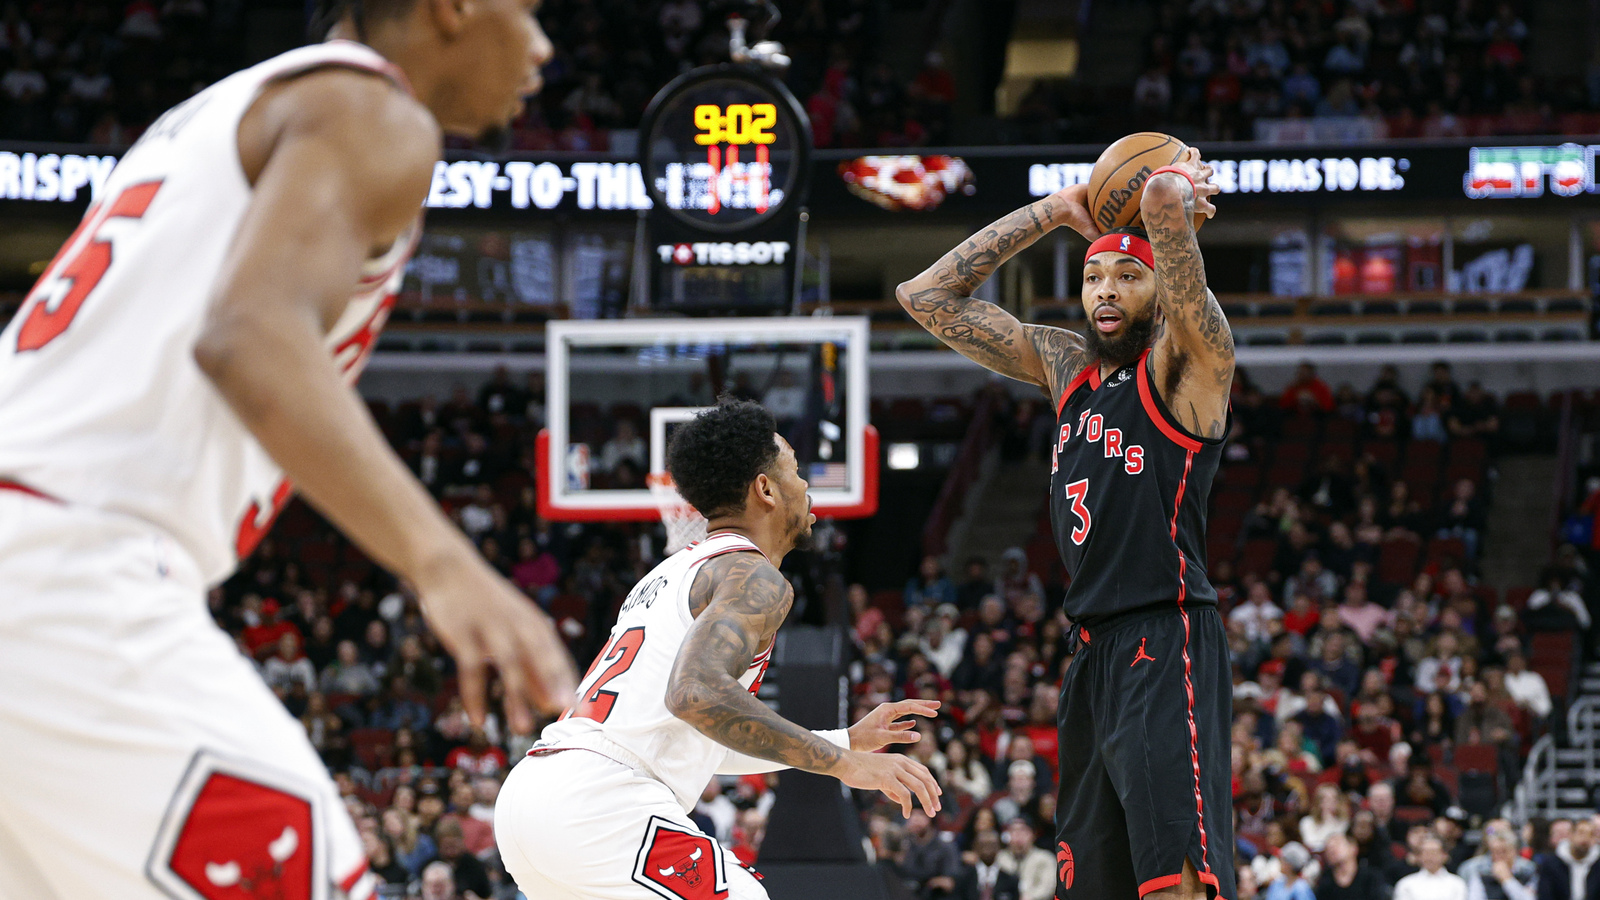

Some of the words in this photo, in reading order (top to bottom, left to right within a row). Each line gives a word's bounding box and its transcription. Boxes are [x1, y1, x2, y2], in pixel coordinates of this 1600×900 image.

[694, 104, 777, 145] 9:02
[1098, 165, 1151, 230] Wilson
[1267, 158, 1323, 192] HAS
[1321, 158, 1360, 192] TO
[13, 176, 164, 354] 5
[1050, 408, 1144, 497] APTORS
[1065, 478, 1091, 546] 3
